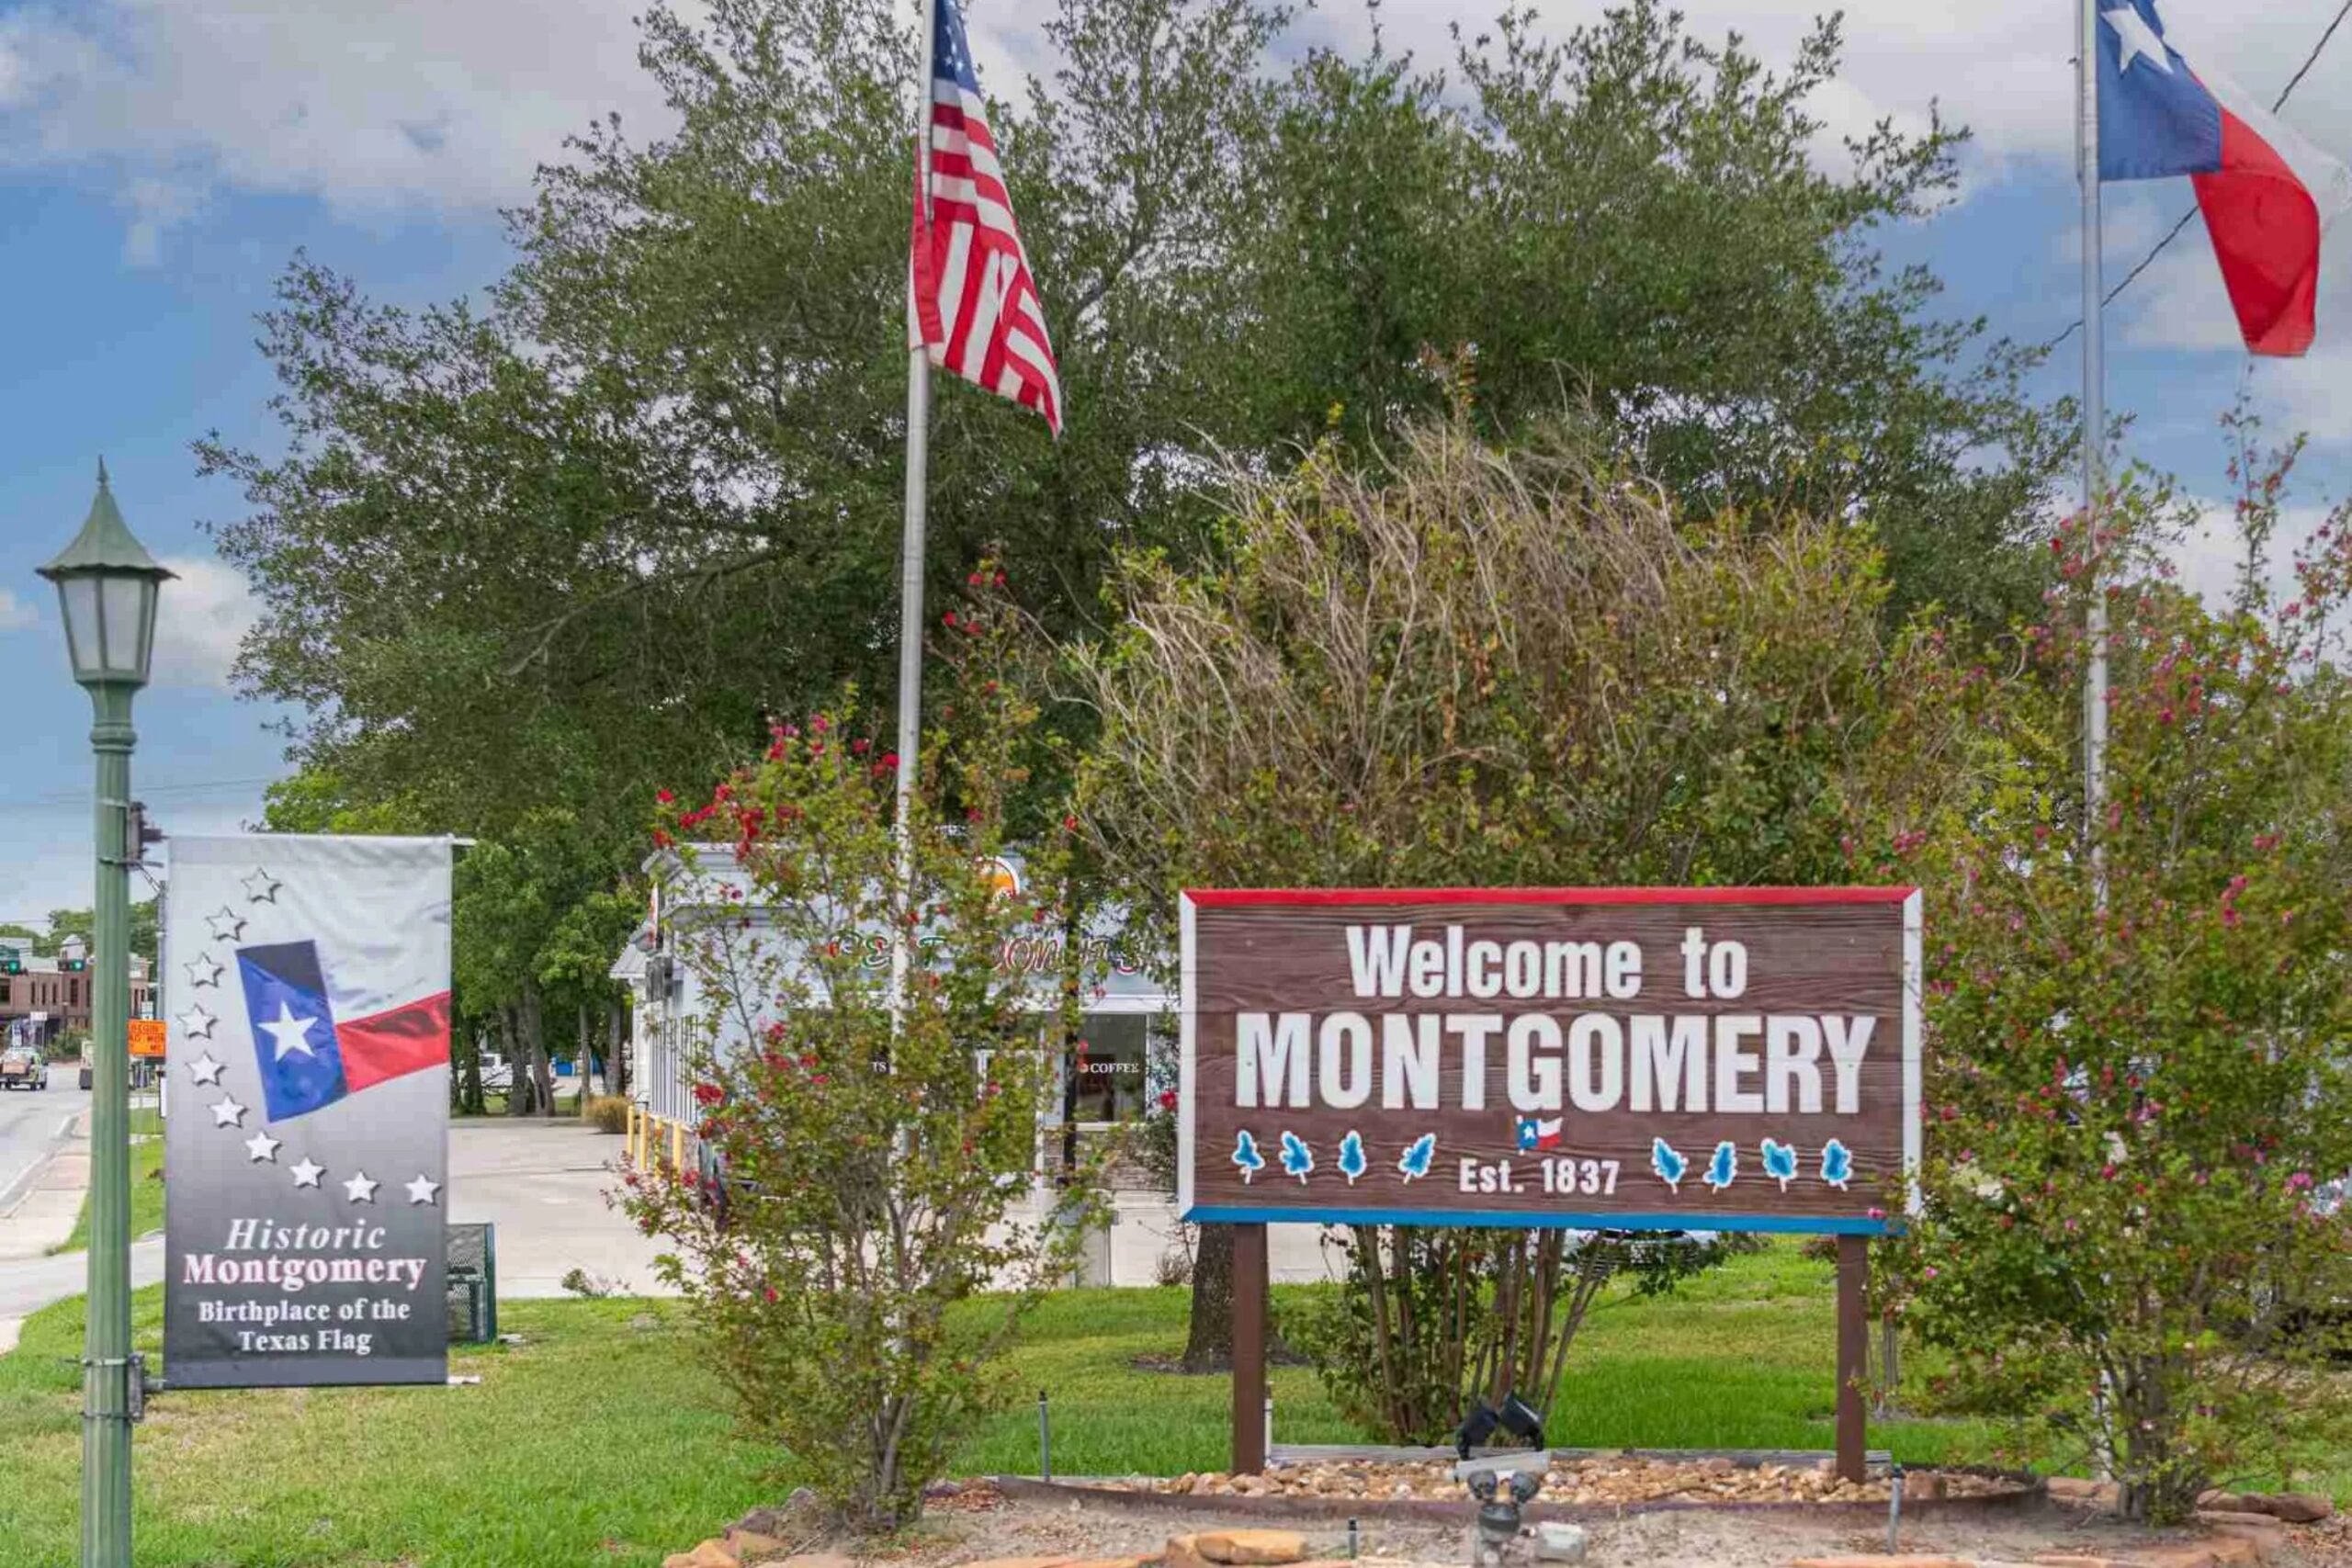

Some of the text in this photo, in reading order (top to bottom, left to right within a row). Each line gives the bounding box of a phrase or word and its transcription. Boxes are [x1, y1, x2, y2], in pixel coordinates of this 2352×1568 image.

[1345, 924, 1747, 999] Welcome to
[1090, 1063, 1139, 1074] COFFEE
[1235, 1011, 1877, 1114] MONTGOMERY
[1459, 1157, 1620, 1195] Est. 1837
[224, 1218, 386, 1250] Historic
[183, 1254, 427, 1292] Montgomery
[198, 1298, 412, 1326] Birthplace of the
[238, 1329, 373, 1356] Texas Flag
